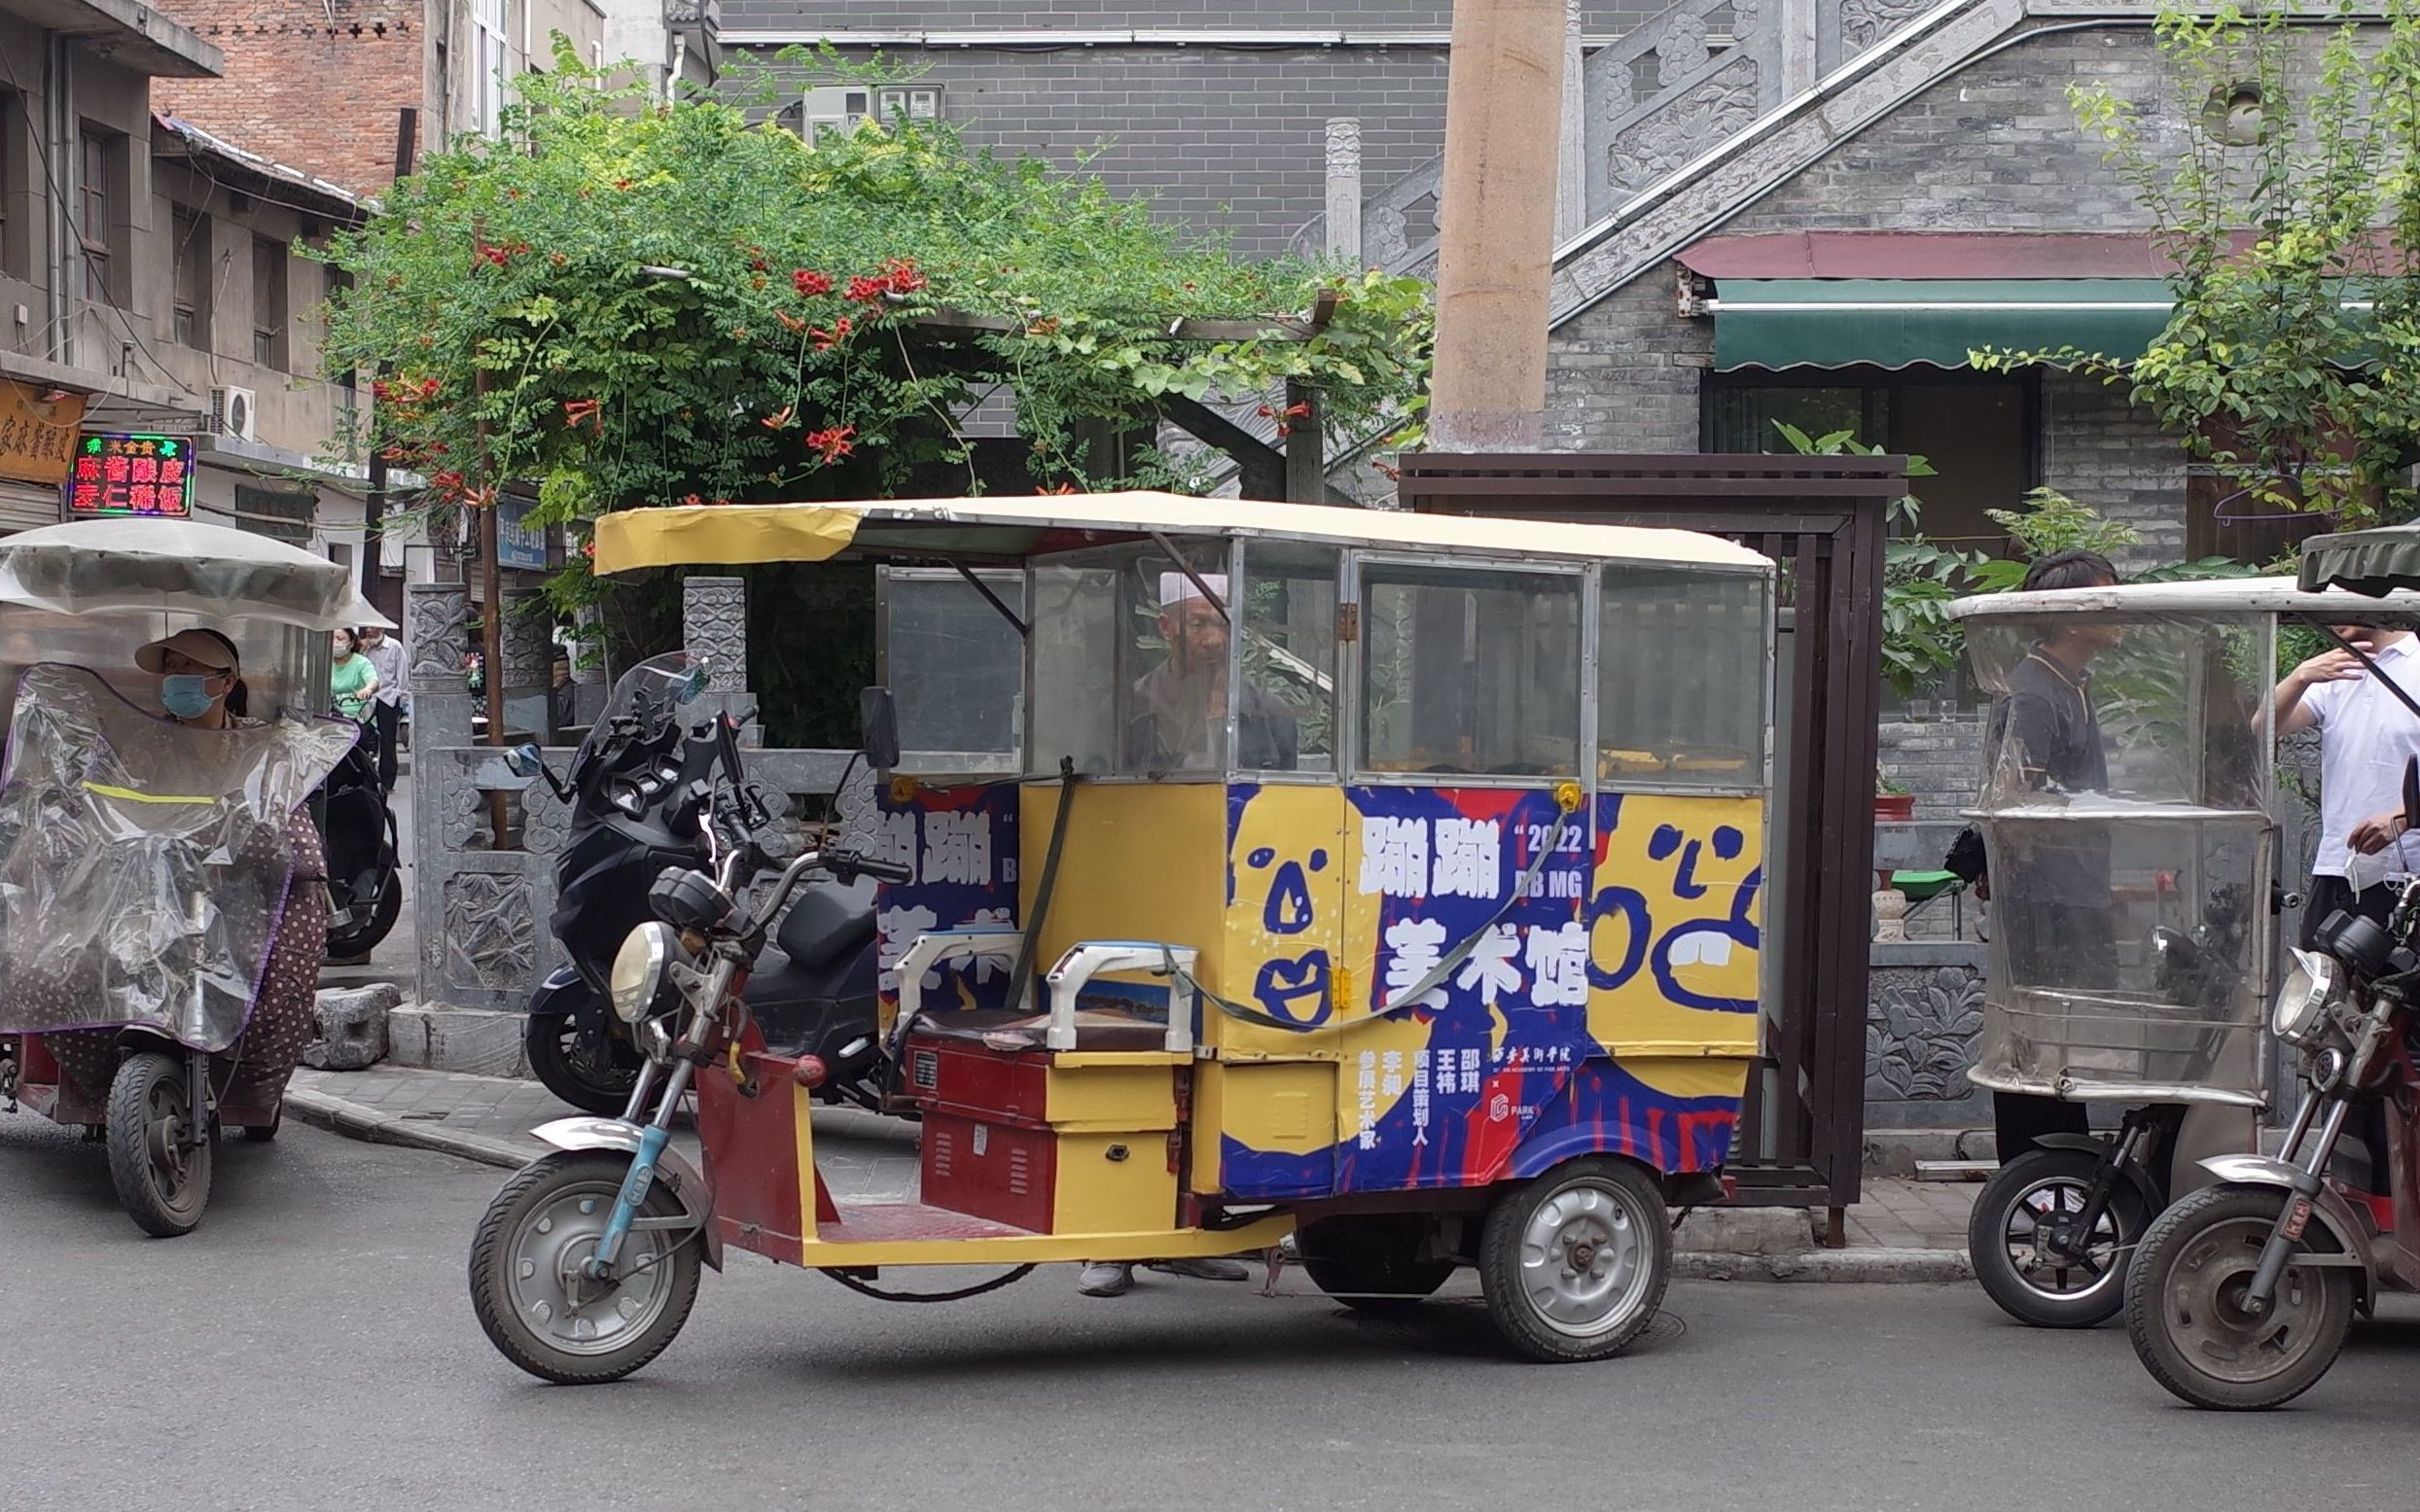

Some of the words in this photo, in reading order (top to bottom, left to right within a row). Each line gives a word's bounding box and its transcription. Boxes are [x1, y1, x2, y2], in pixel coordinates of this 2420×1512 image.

[77, 455, 185, 484] 麻酱酿皮
[75, 482, 184, 510] 麦仁稀饭
[1359, 817, 1501, 899] 蹦蹦
[1548, 870, 1583, 898] MG
[1384, 918, 1590, 1010] 美术馆
[1411, 1048, 1431, 1146] 项目策划人
[1511, 1106, 1534, 1115] PARK
